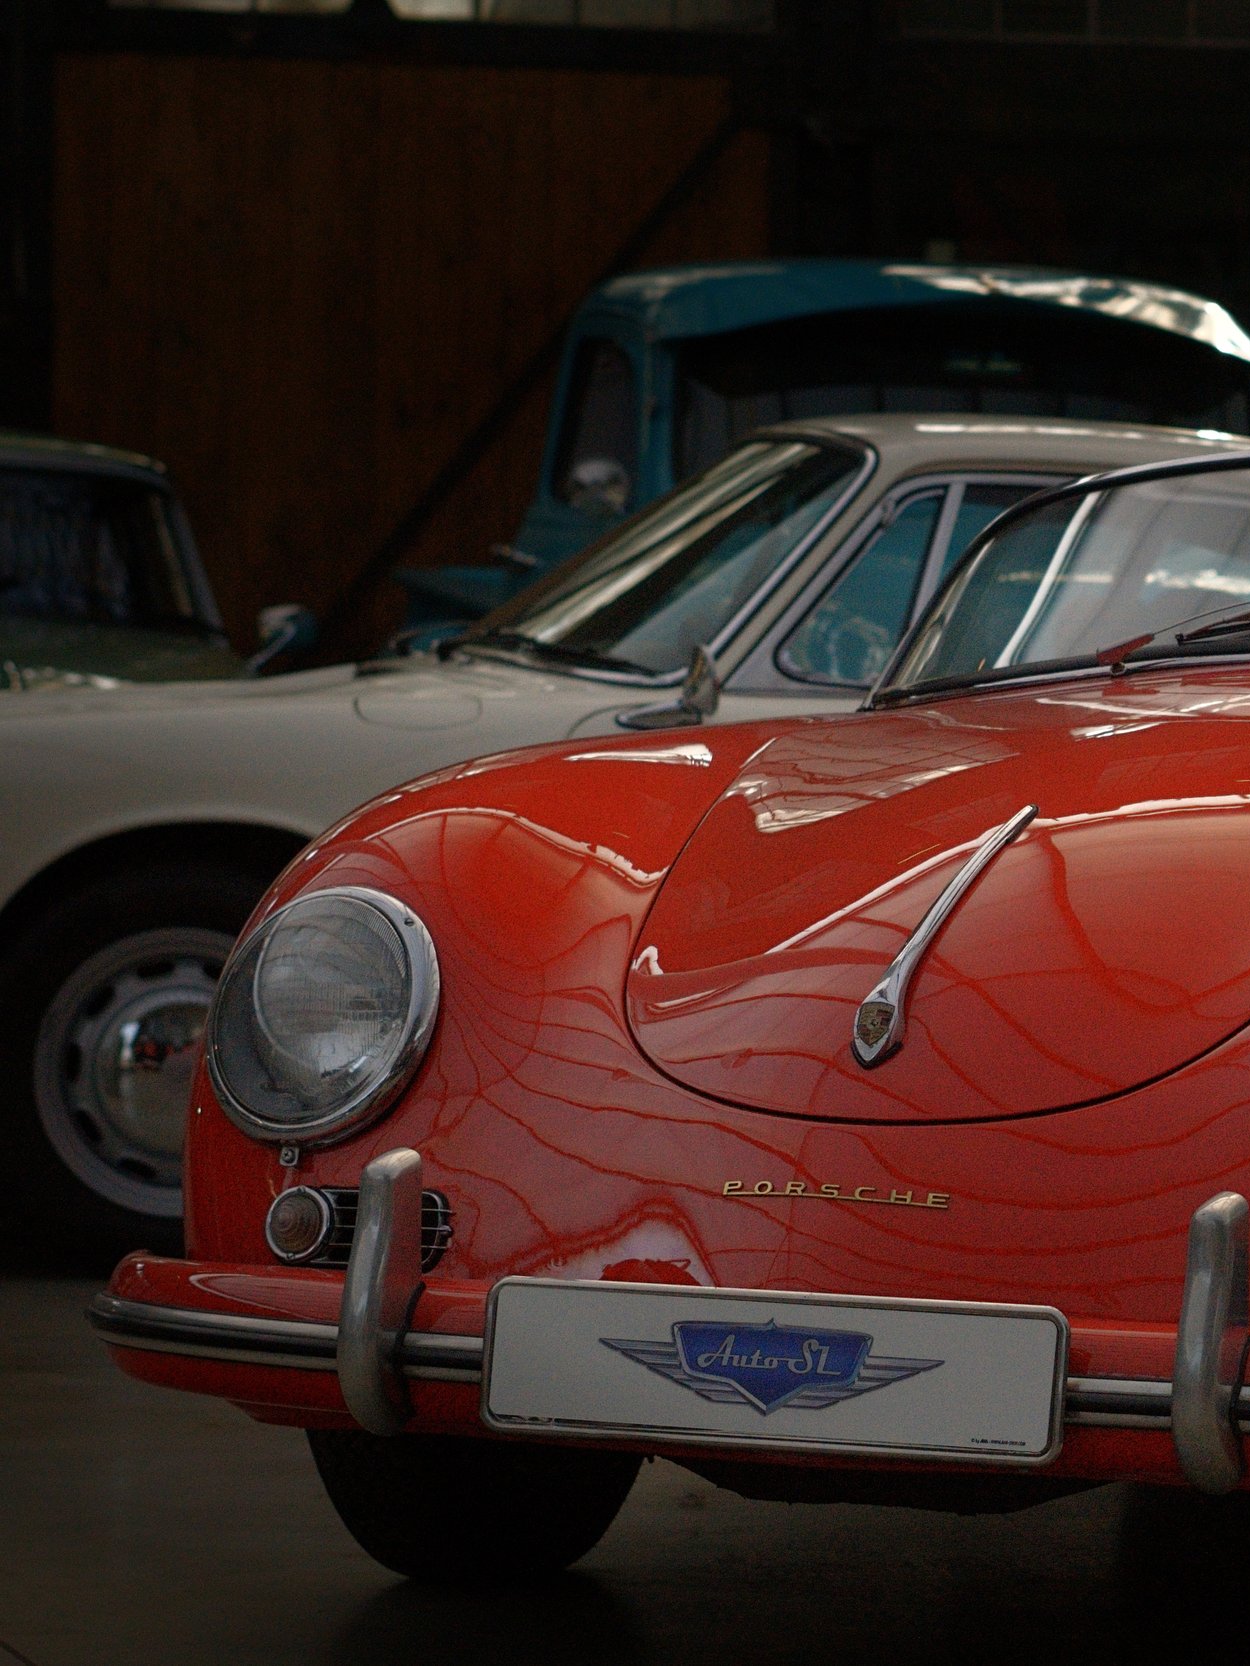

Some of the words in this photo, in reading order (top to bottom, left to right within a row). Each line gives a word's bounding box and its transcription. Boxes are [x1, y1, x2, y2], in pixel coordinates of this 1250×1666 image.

[722, 1180, 950, 1208] PORSCHE
[697, 1334, 778, 1369] Auto
[788, 1339, 841, 1376] SL
